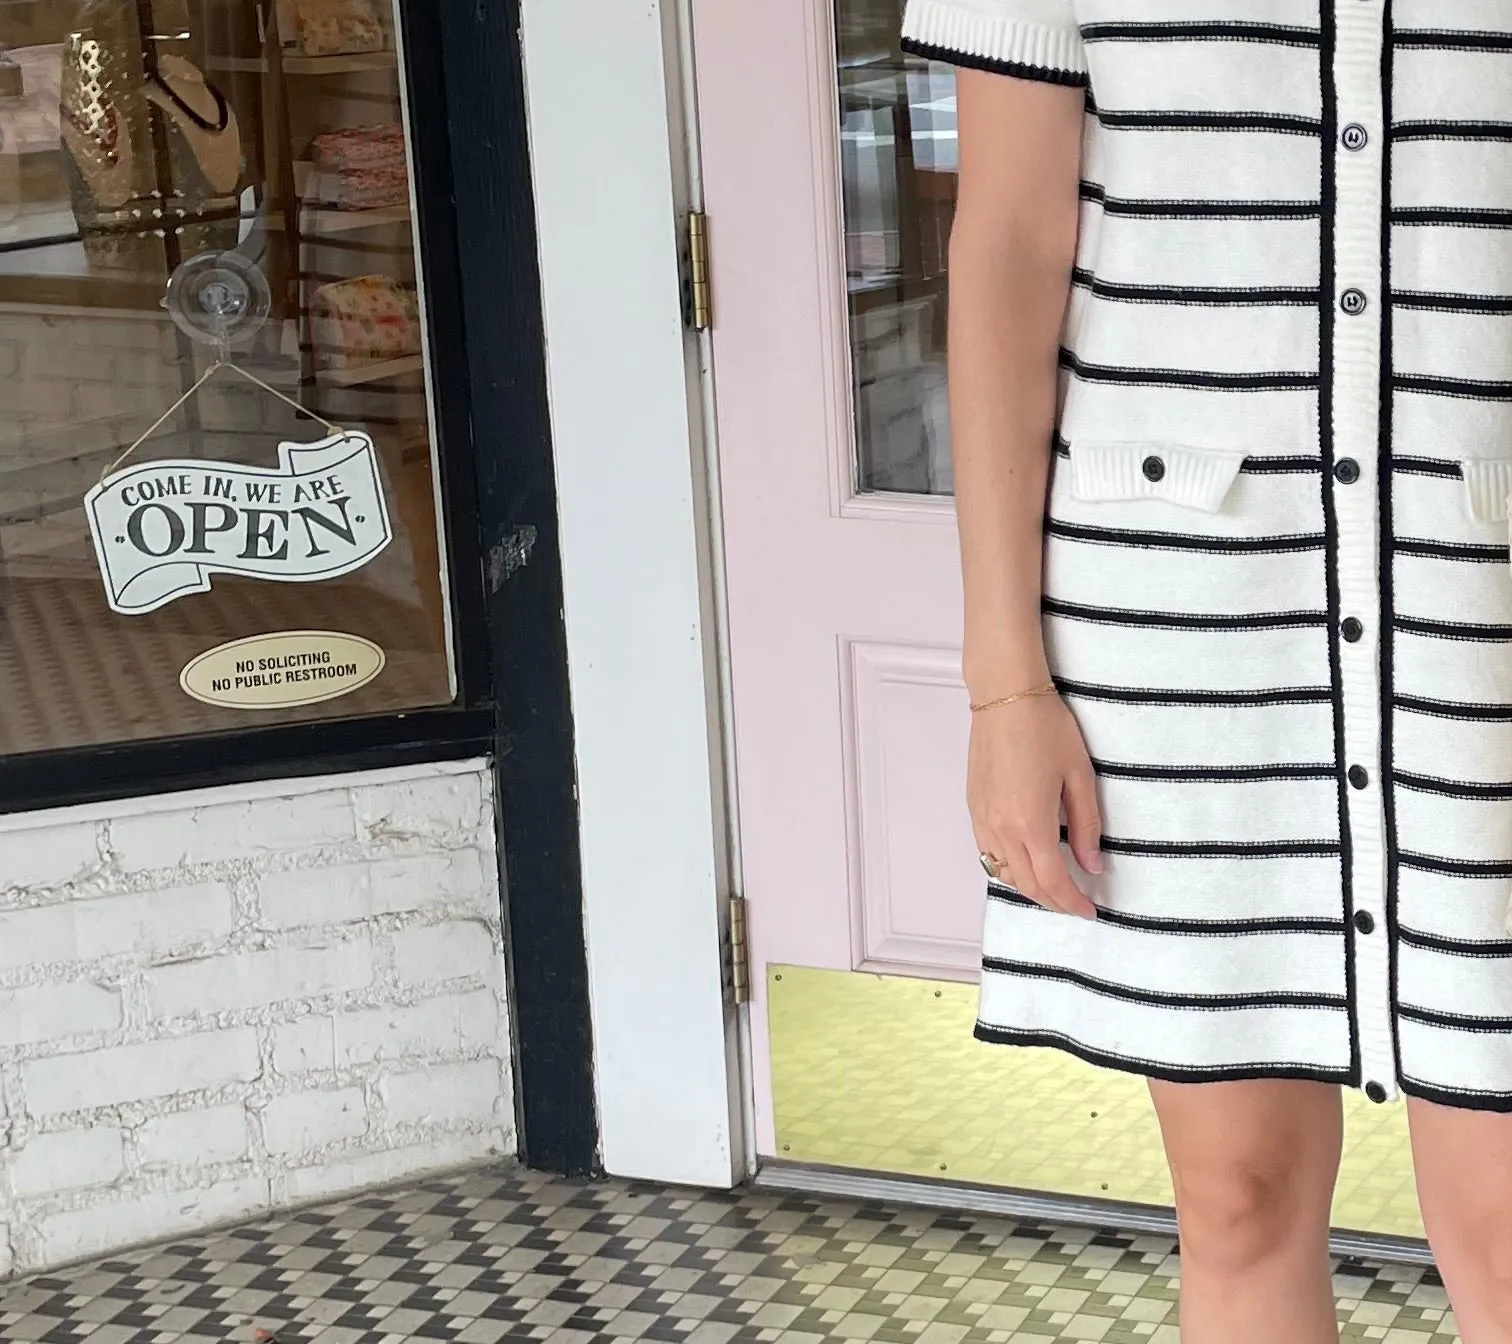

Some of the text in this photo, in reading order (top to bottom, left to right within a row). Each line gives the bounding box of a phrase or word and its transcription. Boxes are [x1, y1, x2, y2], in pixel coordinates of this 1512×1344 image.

[121, 475, 344, 506] COME IN, WE ARE
[127, 496, 357, 560] OPEN
[236, 651, 330, 673] NO SOLICITING
[212, 663, 357, 691] NO PUBLIC RESTROOM
